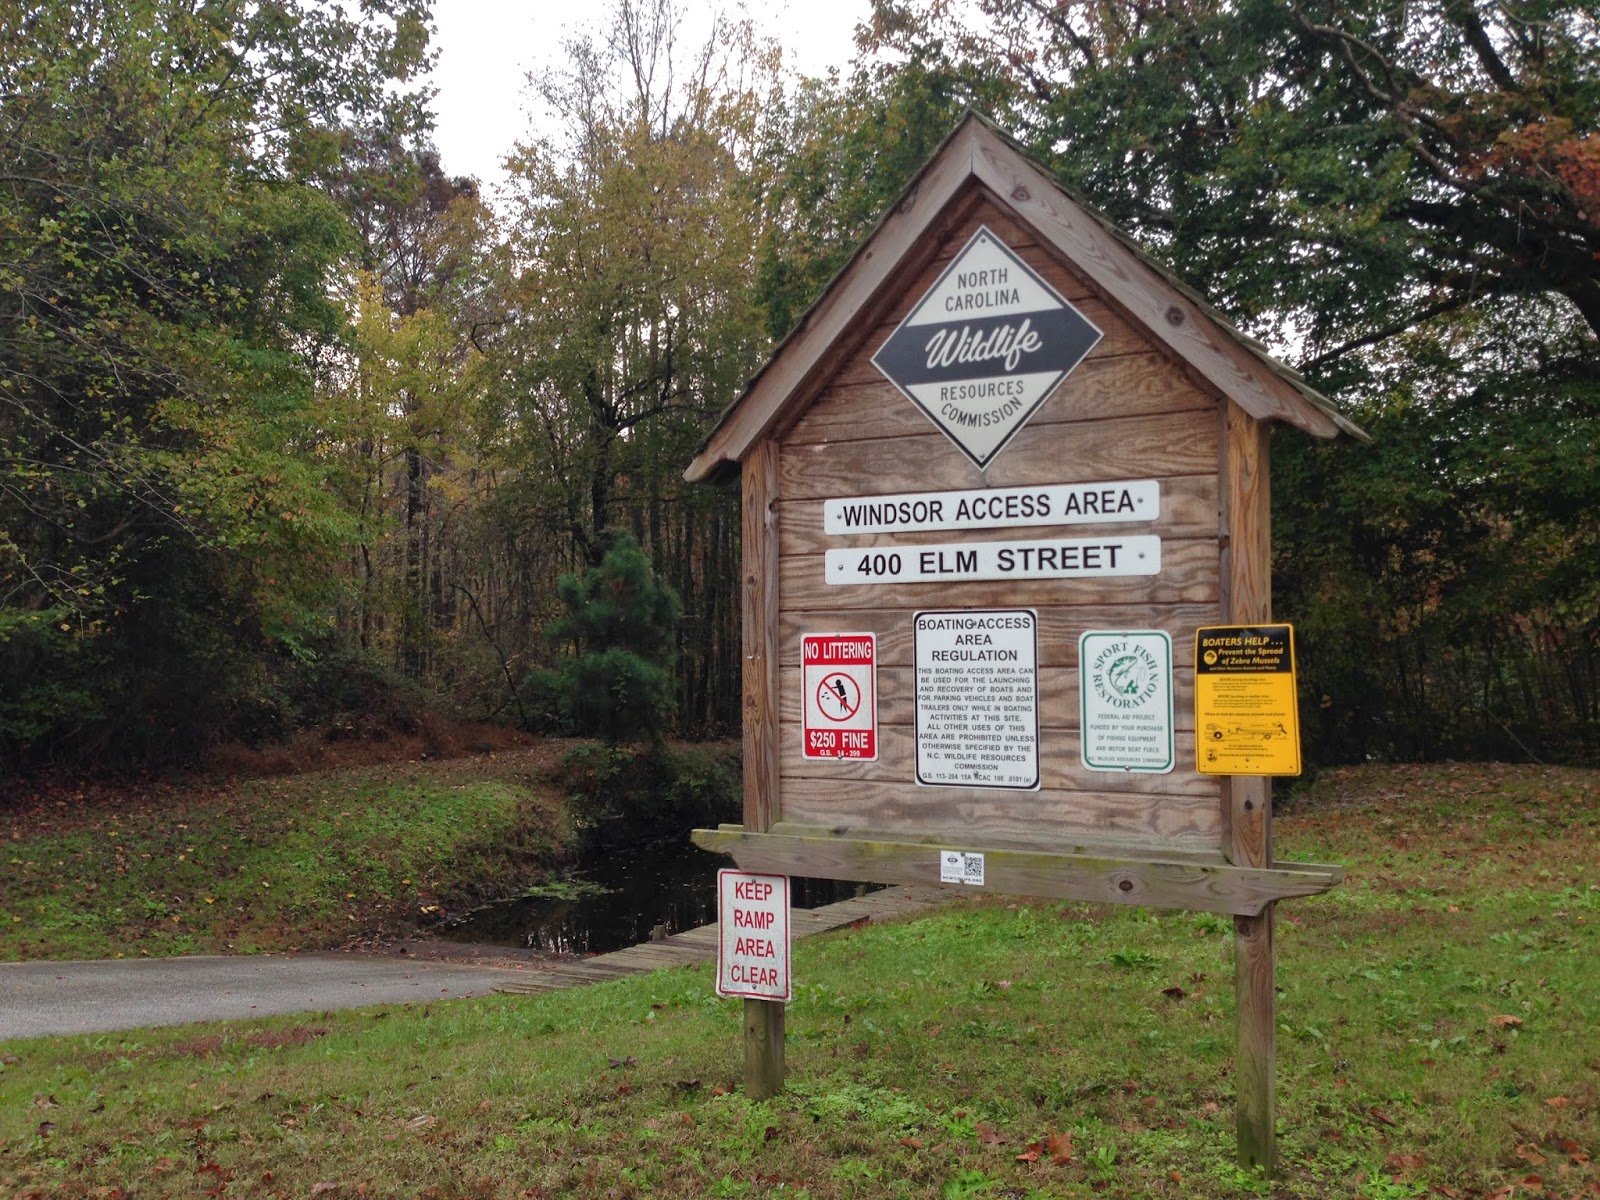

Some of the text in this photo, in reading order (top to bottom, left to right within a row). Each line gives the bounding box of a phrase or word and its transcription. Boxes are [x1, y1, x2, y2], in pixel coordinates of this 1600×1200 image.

[958, 268, 1008, 289] NORTH
[946, 288, 1020, 312] CAROLINA
[925, 318, 1042, 372] Wildlife
[941, 380, 1024, 401] RESOURCES
[941, 396, 1022, 428] COMMISSION
[844, 490, 1135, 526] WINDSOR ACCESS AREA
[858, 545, 1122, 576] 400 ELM STREET
[919, 618, 1030, 630] BOATING ACCESS
[955, 635, 992, 645] AREA
[1203, 638, 1242, 646] BOATERS
[805, 642, 871, 659] NO LITTERING
[932, 650, 1017, 661] REGULATION
[1094, 642, 1157, 670] SPORT FISH
[1093, 672, 1158, 708] RESTORATION
[810, 731, 868, 749] $250 FINE
[735, 882, 772, 900] KEEP
[734, 910, 774, 929] RAMP
[735, 938, 775, 958] AREA
[731, 966, 777, 986] CLEAR
